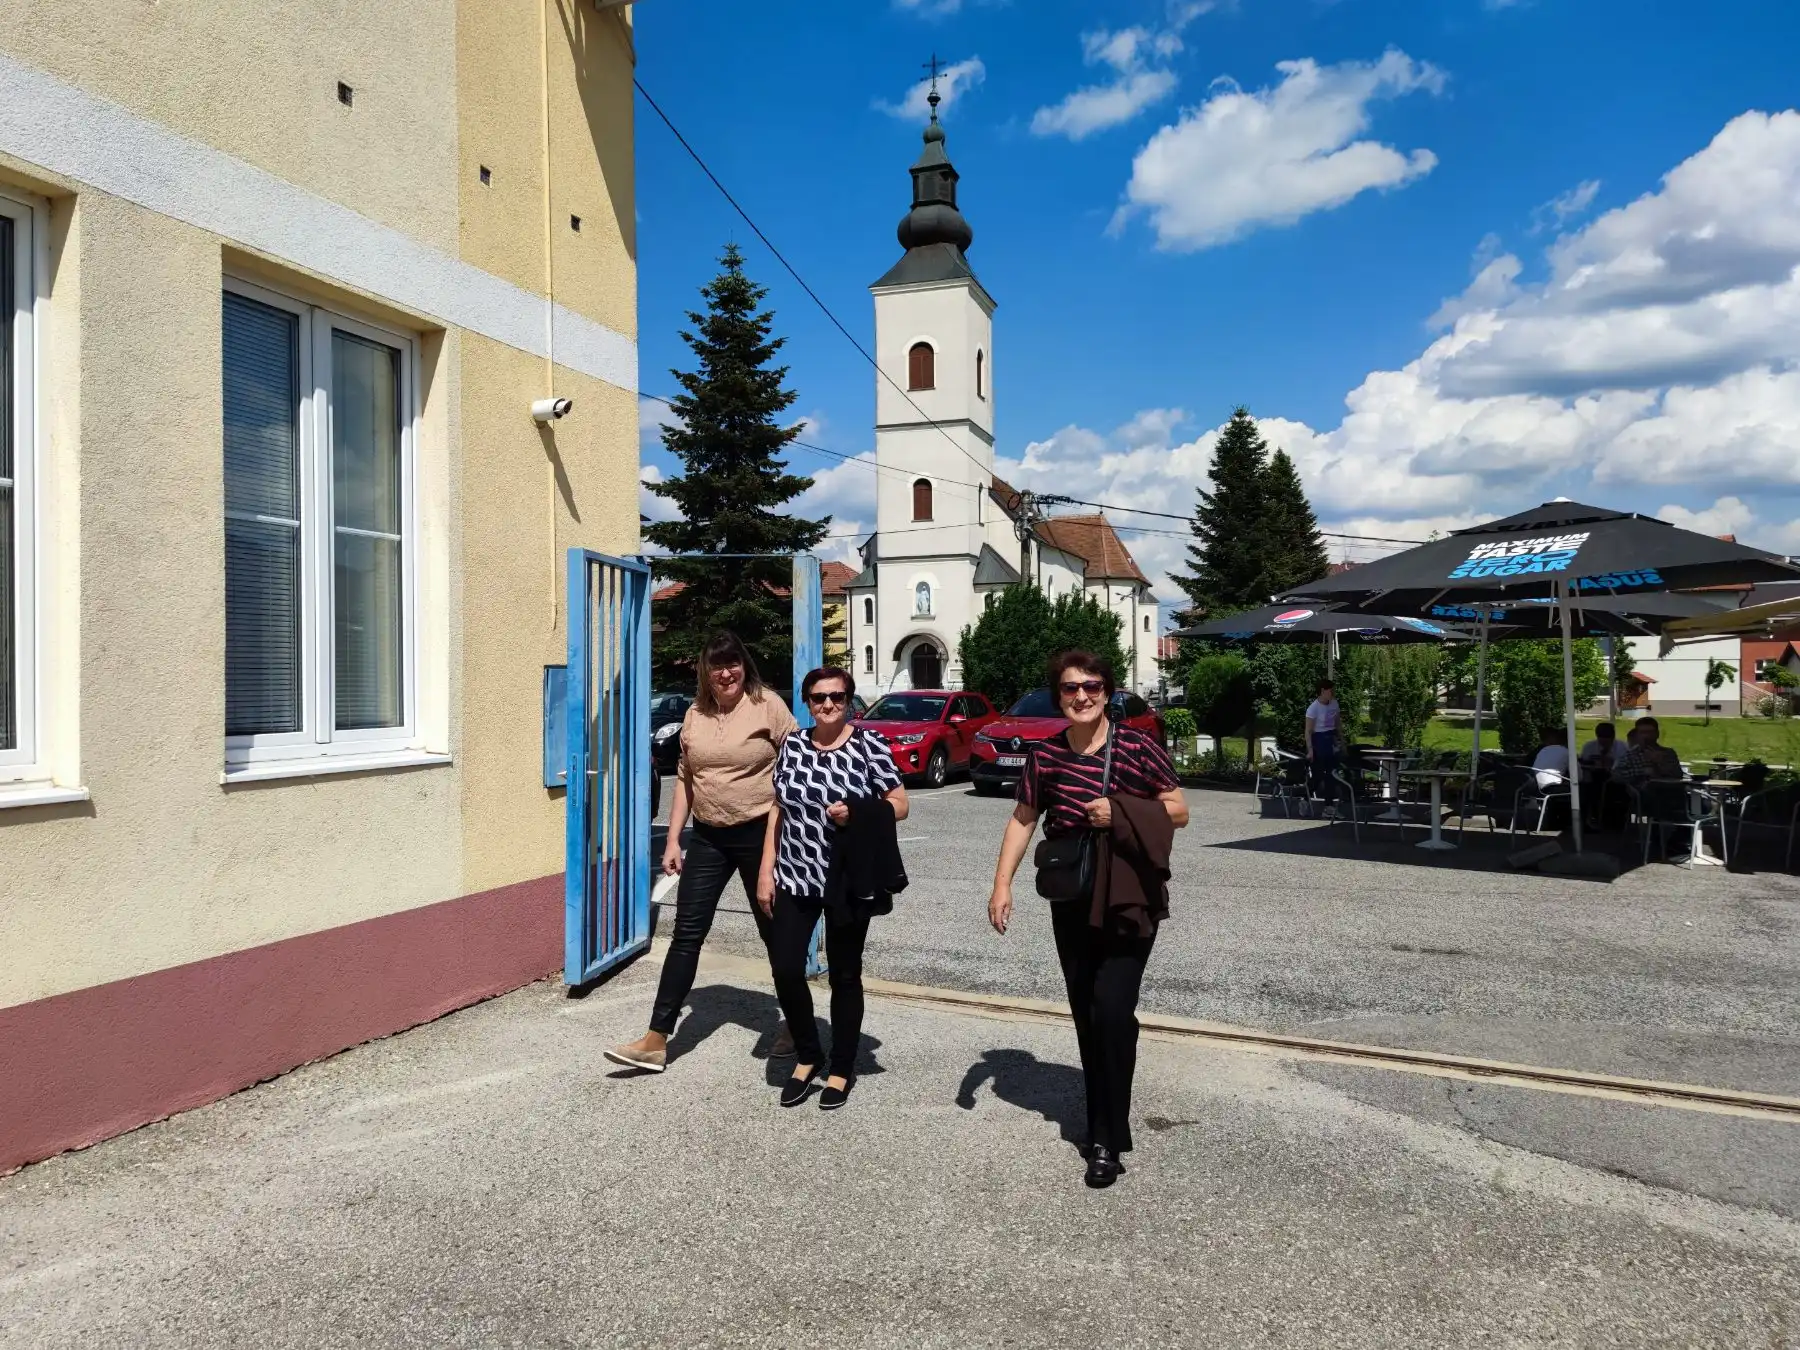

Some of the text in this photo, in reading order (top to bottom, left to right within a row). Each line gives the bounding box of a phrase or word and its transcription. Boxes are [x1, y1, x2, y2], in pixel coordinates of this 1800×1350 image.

[1467, 539, 1589, 560] TASTE
[1473, 532, 1591, 550] MAXIMUM
[1447, 559, 1572, 579] SUGAR
[1456, 549, 1578, 569] ZERO
